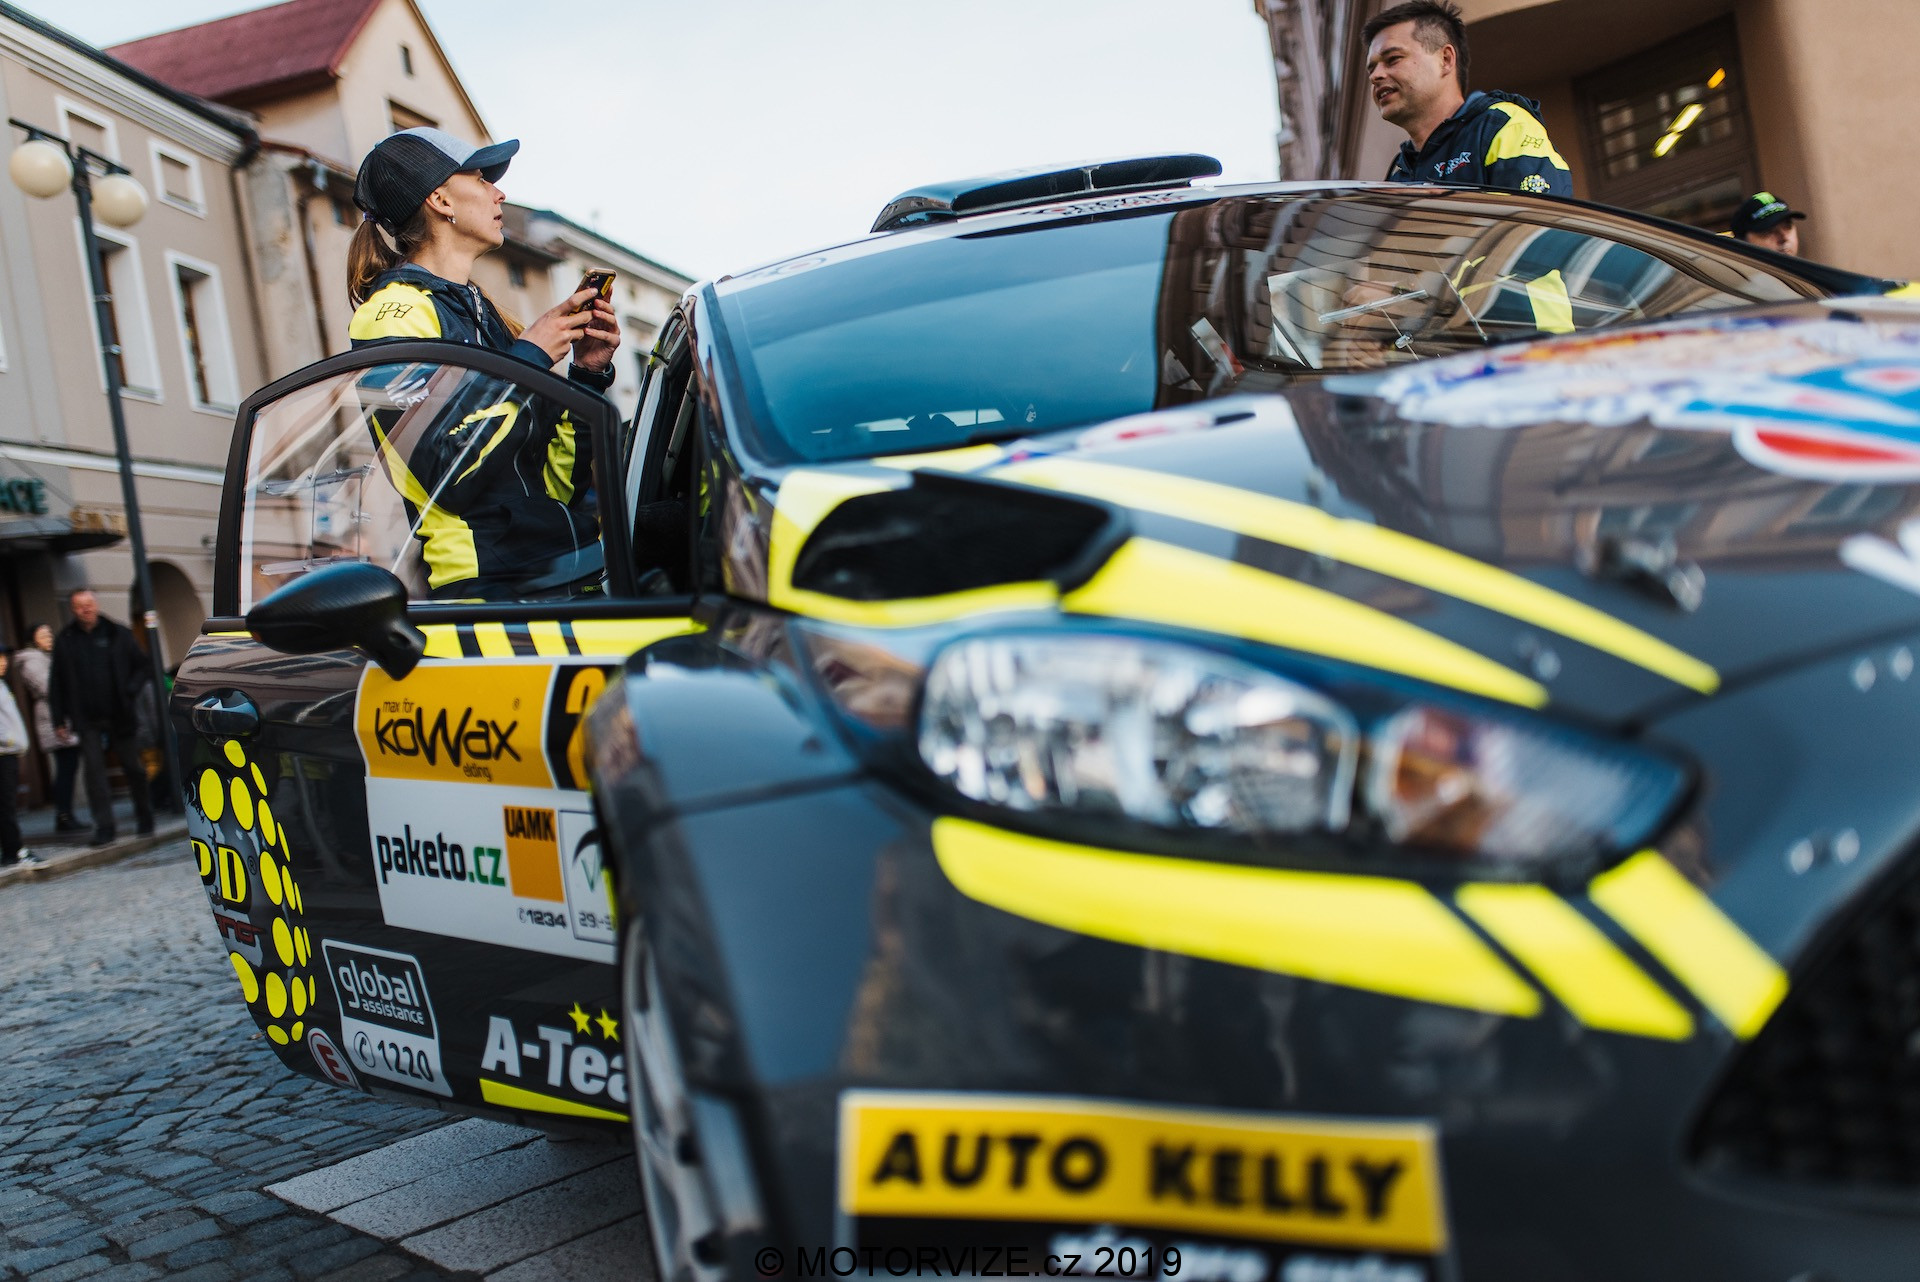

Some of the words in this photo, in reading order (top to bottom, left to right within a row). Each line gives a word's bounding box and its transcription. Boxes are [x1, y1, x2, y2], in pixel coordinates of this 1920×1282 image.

[376, 824, 506, 887] paketo.cz
[526, 909, 567, 929] 1234
[338, 960, 420, 1009] global
[362, 999, 425, 1025] assistance
[377, 1040, 434, 1083] 1220
[871, 1129, 1110, 1194] AUTO
[1147, 1142, 1406, 1221] KELLY
